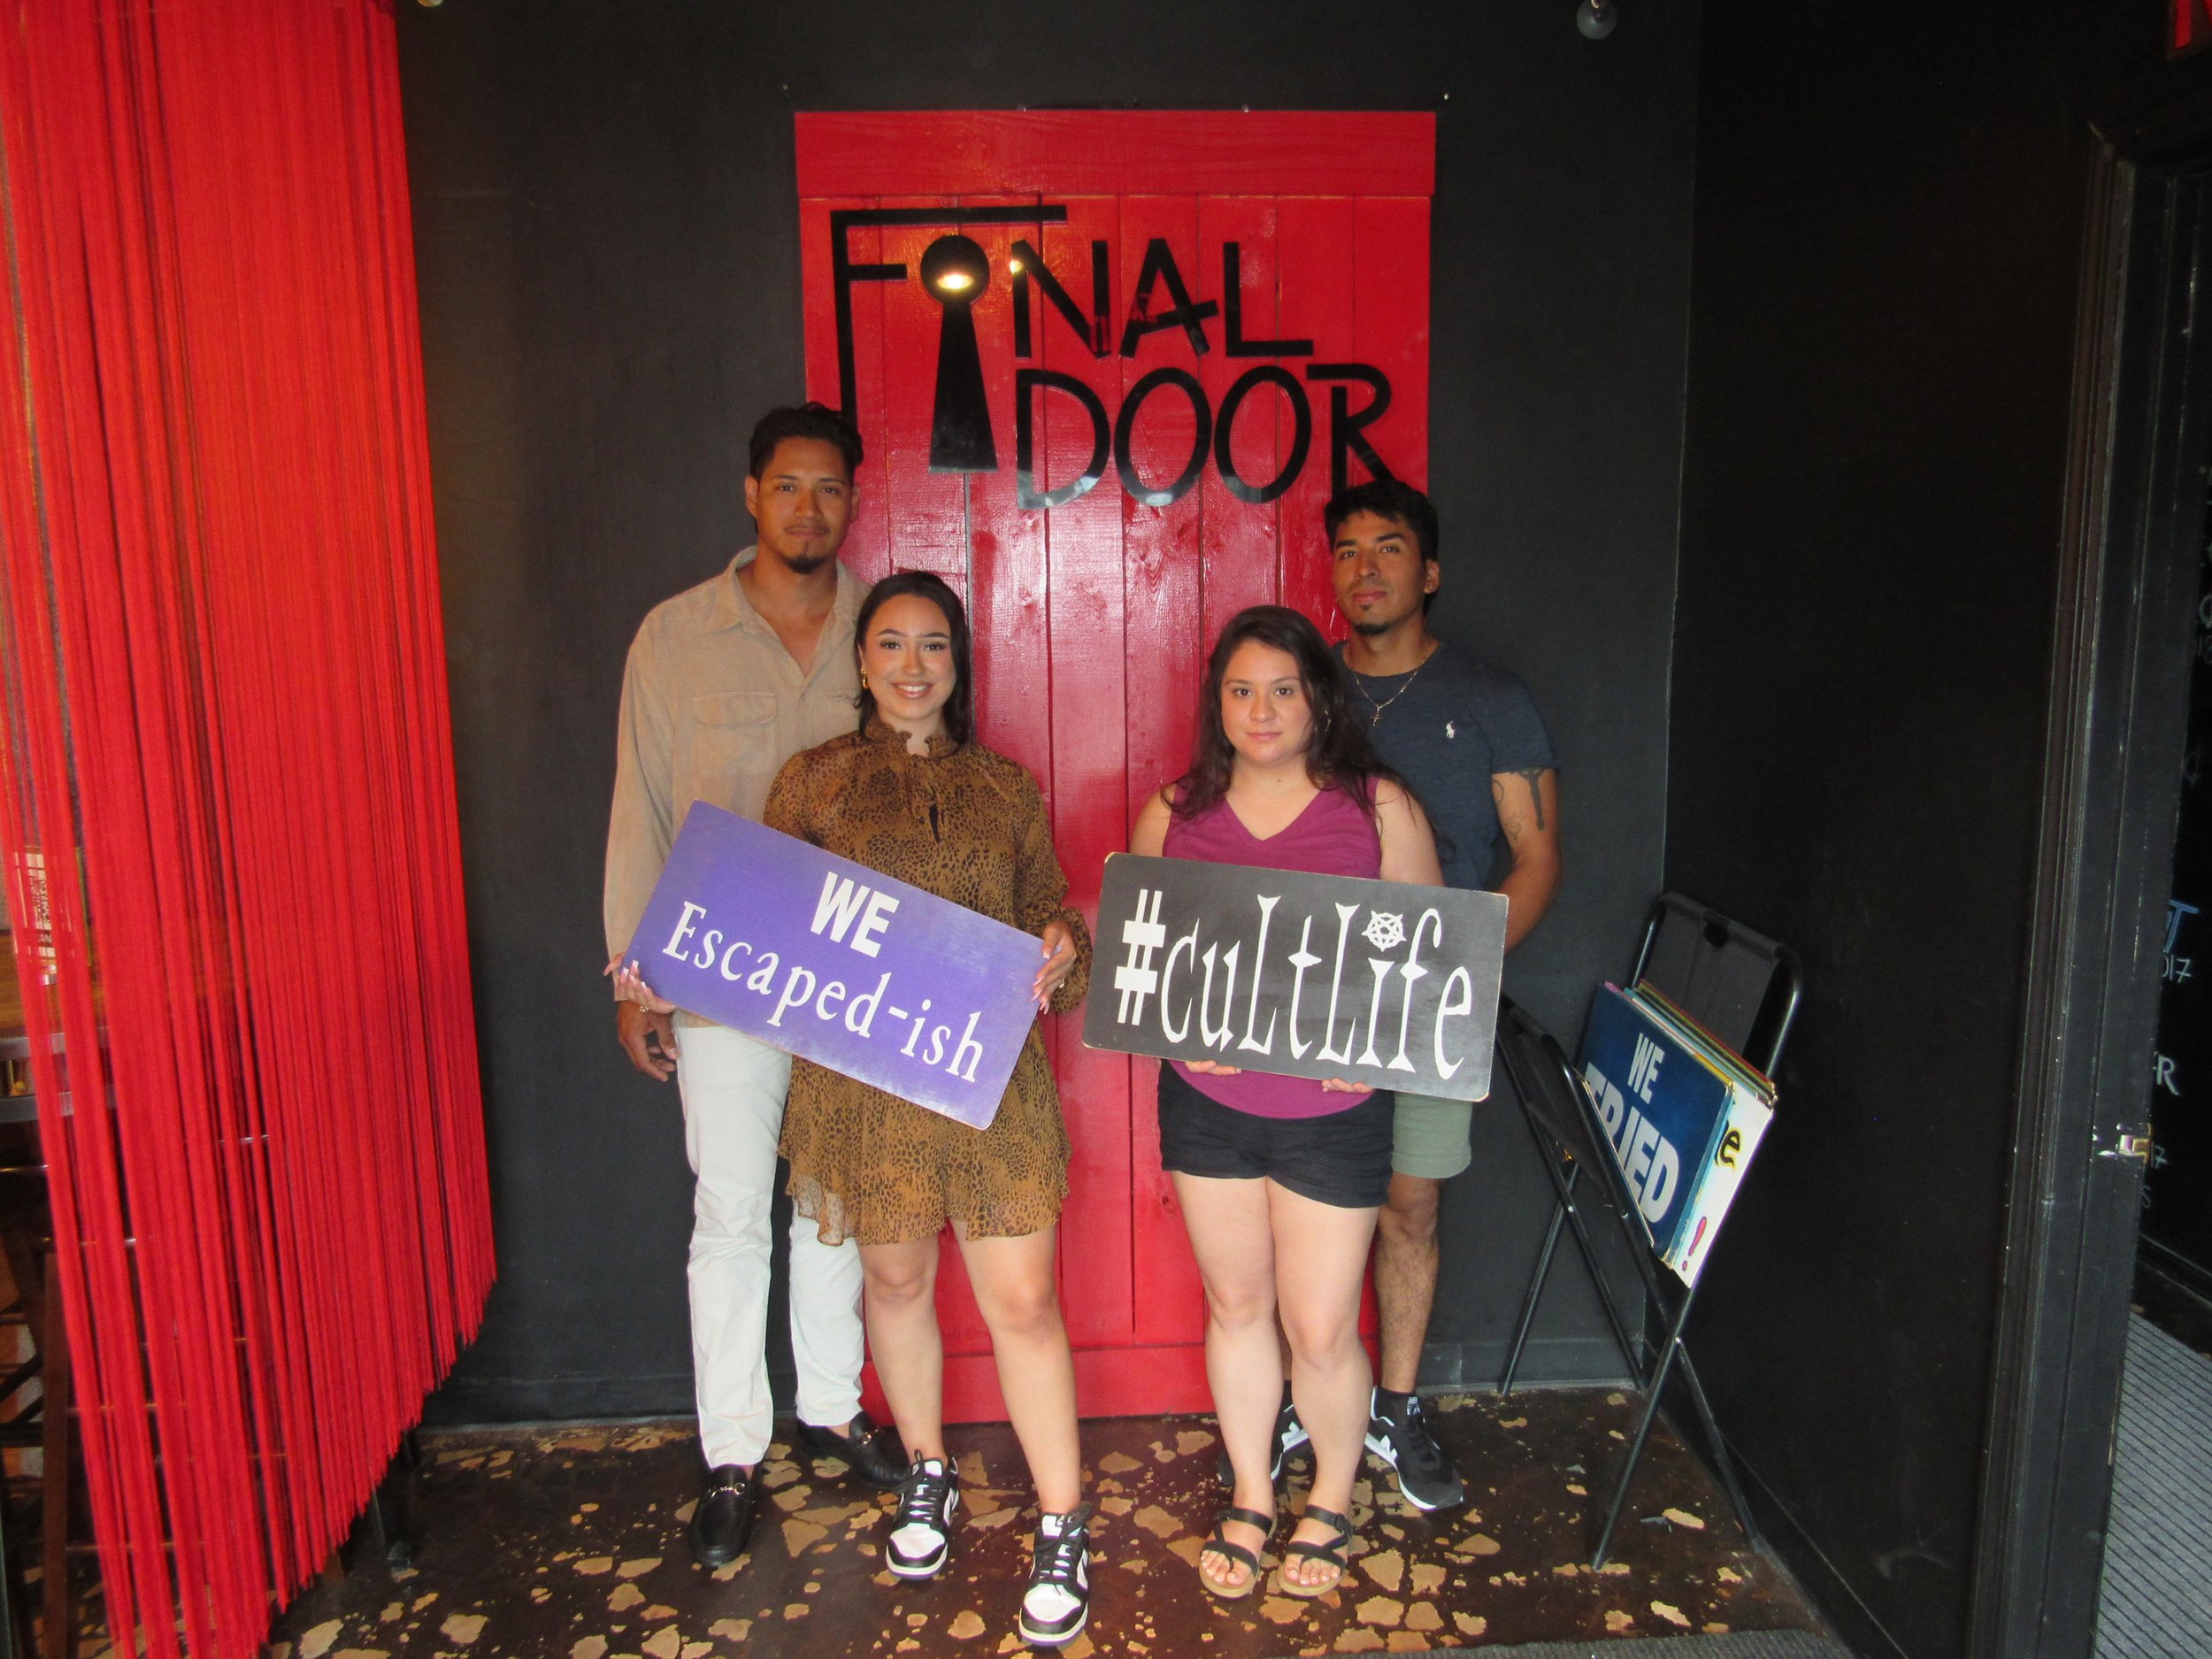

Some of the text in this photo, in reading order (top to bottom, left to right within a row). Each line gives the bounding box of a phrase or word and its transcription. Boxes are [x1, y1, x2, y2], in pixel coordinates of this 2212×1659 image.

[1017, 363, 1395, 510] DOOR
[810, 871, 900, 958] WE
[663, 901, 985, 1083] Escaped-ish
[1628, 1033, 1665, 1104] WE
